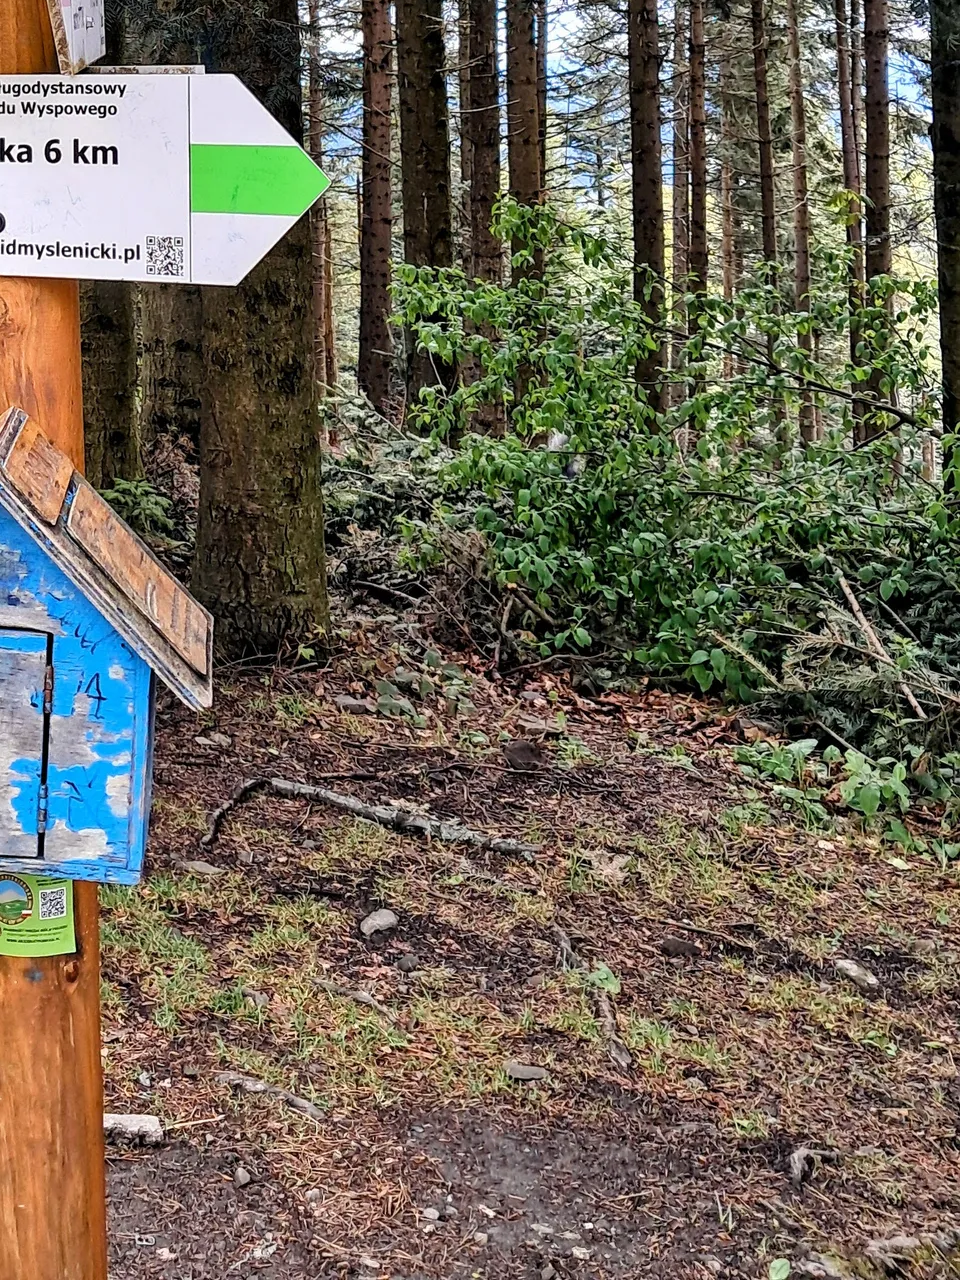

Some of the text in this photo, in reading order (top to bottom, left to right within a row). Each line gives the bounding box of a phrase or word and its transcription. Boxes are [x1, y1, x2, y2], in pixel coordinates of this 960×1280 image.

[21, 101, 118, 119] Wyspowego
[44, 138, 62, 164] 6
[73, 138, 119, 165] km
